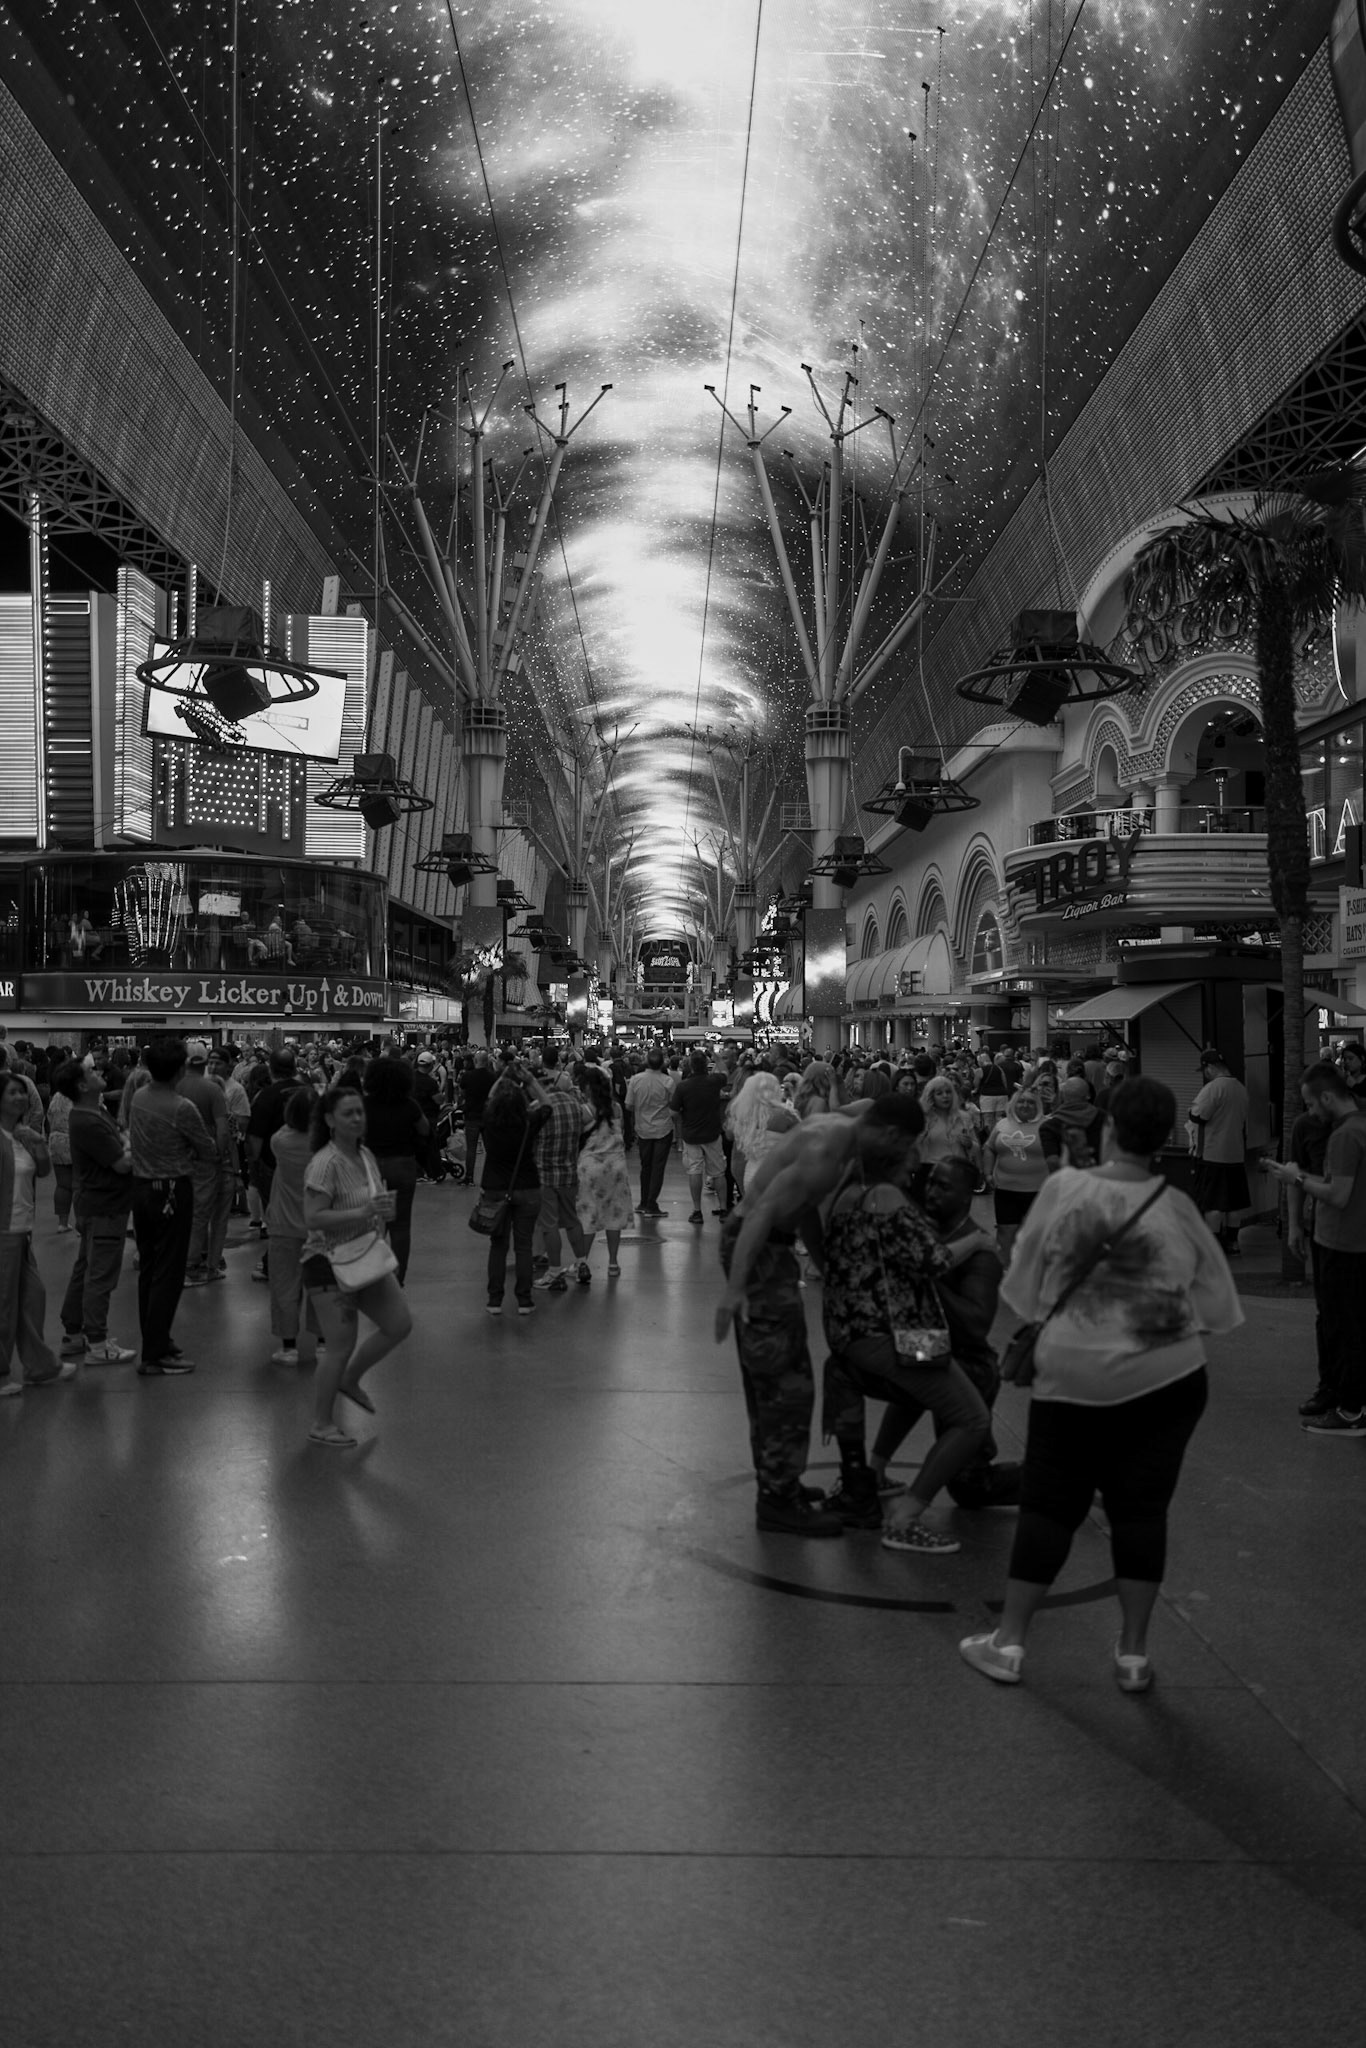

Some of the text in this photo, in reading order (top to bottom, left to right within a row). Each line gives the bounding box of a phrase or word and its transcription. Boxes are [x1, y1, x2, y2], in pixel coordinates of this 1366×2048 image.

[1005, 829, 1142, 905] TROY
[1062, 893, 1125, 920] Liquor Bar
[1346, 924, 1363, 942] HATS
[84, 977, 191, 1008] Whiskey
[198, 979, 281, 1005] Licker
[287, 984, 318, 1011] Up
[333, 984, 349, 1006] &
[352, 985, 384, 1008] Down
